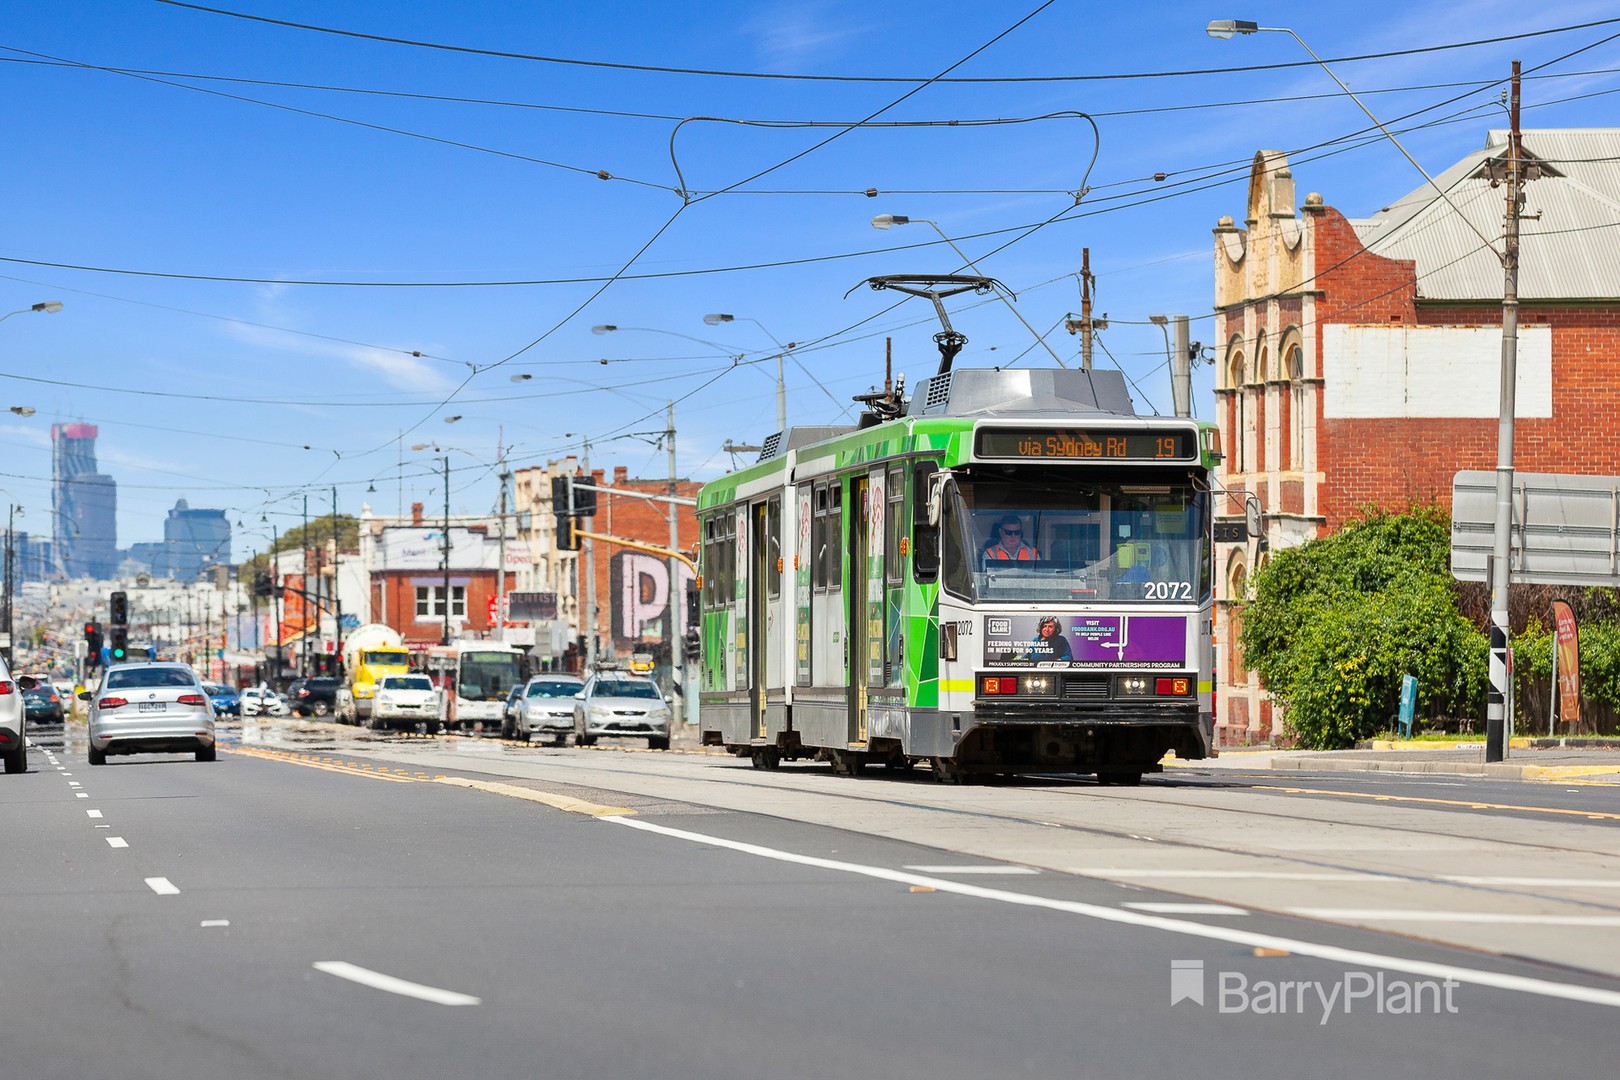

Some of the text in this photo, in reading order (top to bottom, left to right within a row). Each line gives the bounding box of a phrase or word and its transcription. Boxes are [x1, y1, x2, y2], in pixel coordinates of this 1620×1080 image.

[1018, 436, 1175, 457] via Sydney Rd 19
[510, 593, 556, 604] DENTIST
[1144, 581, 1193, 600] 2072
[957, 620, 973, 635] 2072
